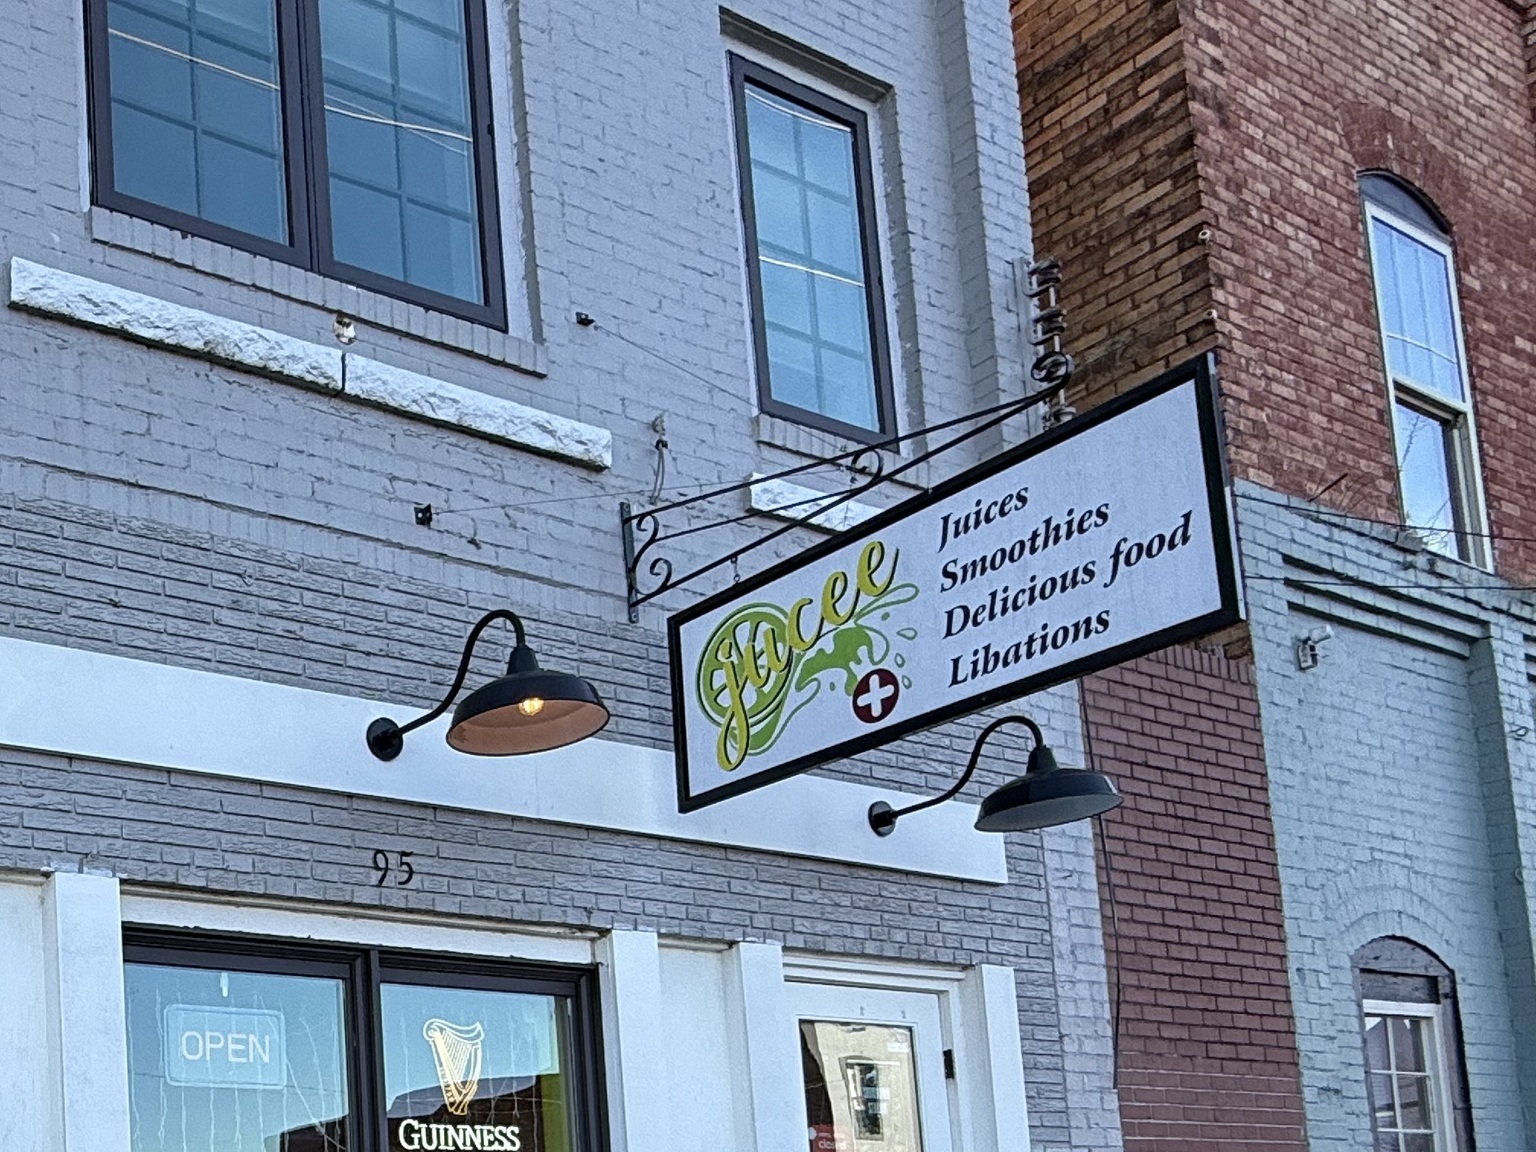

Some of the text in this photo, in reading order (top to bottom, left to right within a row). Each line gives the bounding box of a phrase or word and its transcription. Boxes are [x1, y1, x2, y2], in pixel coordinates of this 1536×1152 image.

[938, 486, 1029, 553] Juices
[940, 503, 1110, 593] Smoothies
[942, 509, 1193, 639] Delicious food
[948, 609, 1111, 688] Libations
[373, 849, 414, 887] 95
[181, 1030, 270, 1063] OPEN
